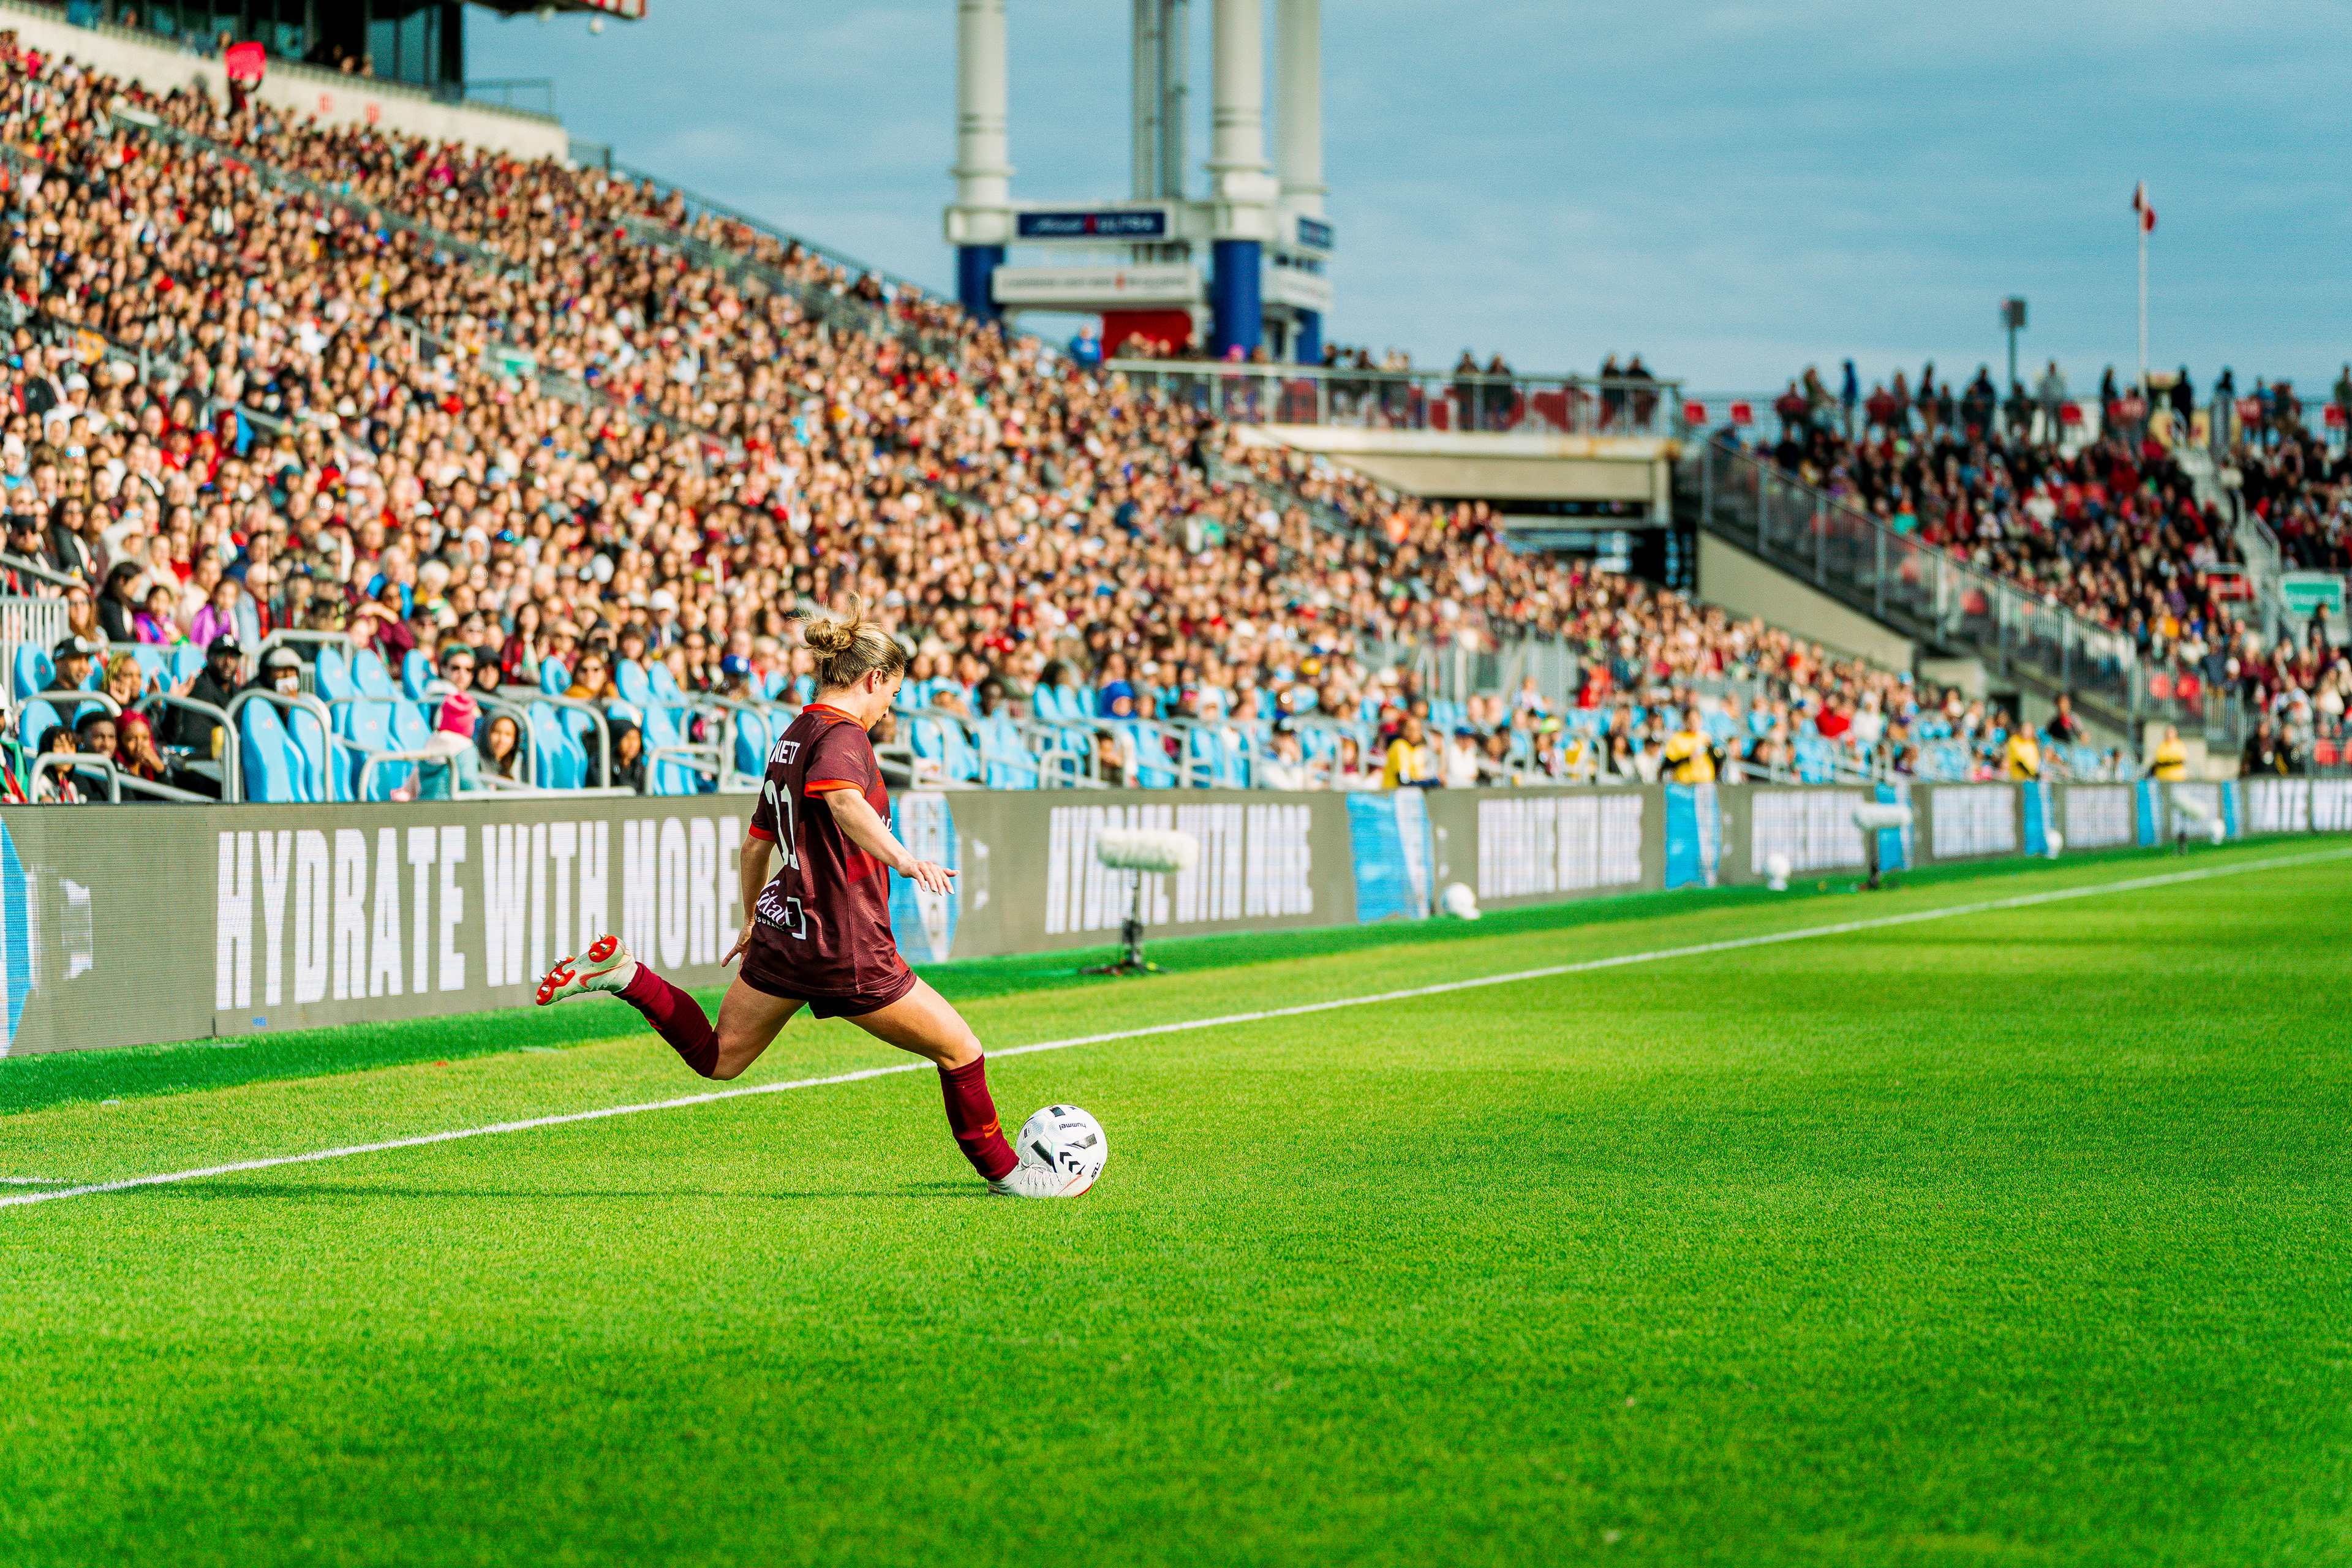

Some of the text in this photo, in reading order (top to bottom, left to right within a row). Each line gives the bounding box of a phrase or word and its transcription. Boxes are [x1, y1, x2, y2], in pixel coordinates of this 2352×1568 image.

[216, 826, 466, 1010] HYDRATE
[482, 821, 608, 987] WITH
[622, 816, 741, 970] MORE
